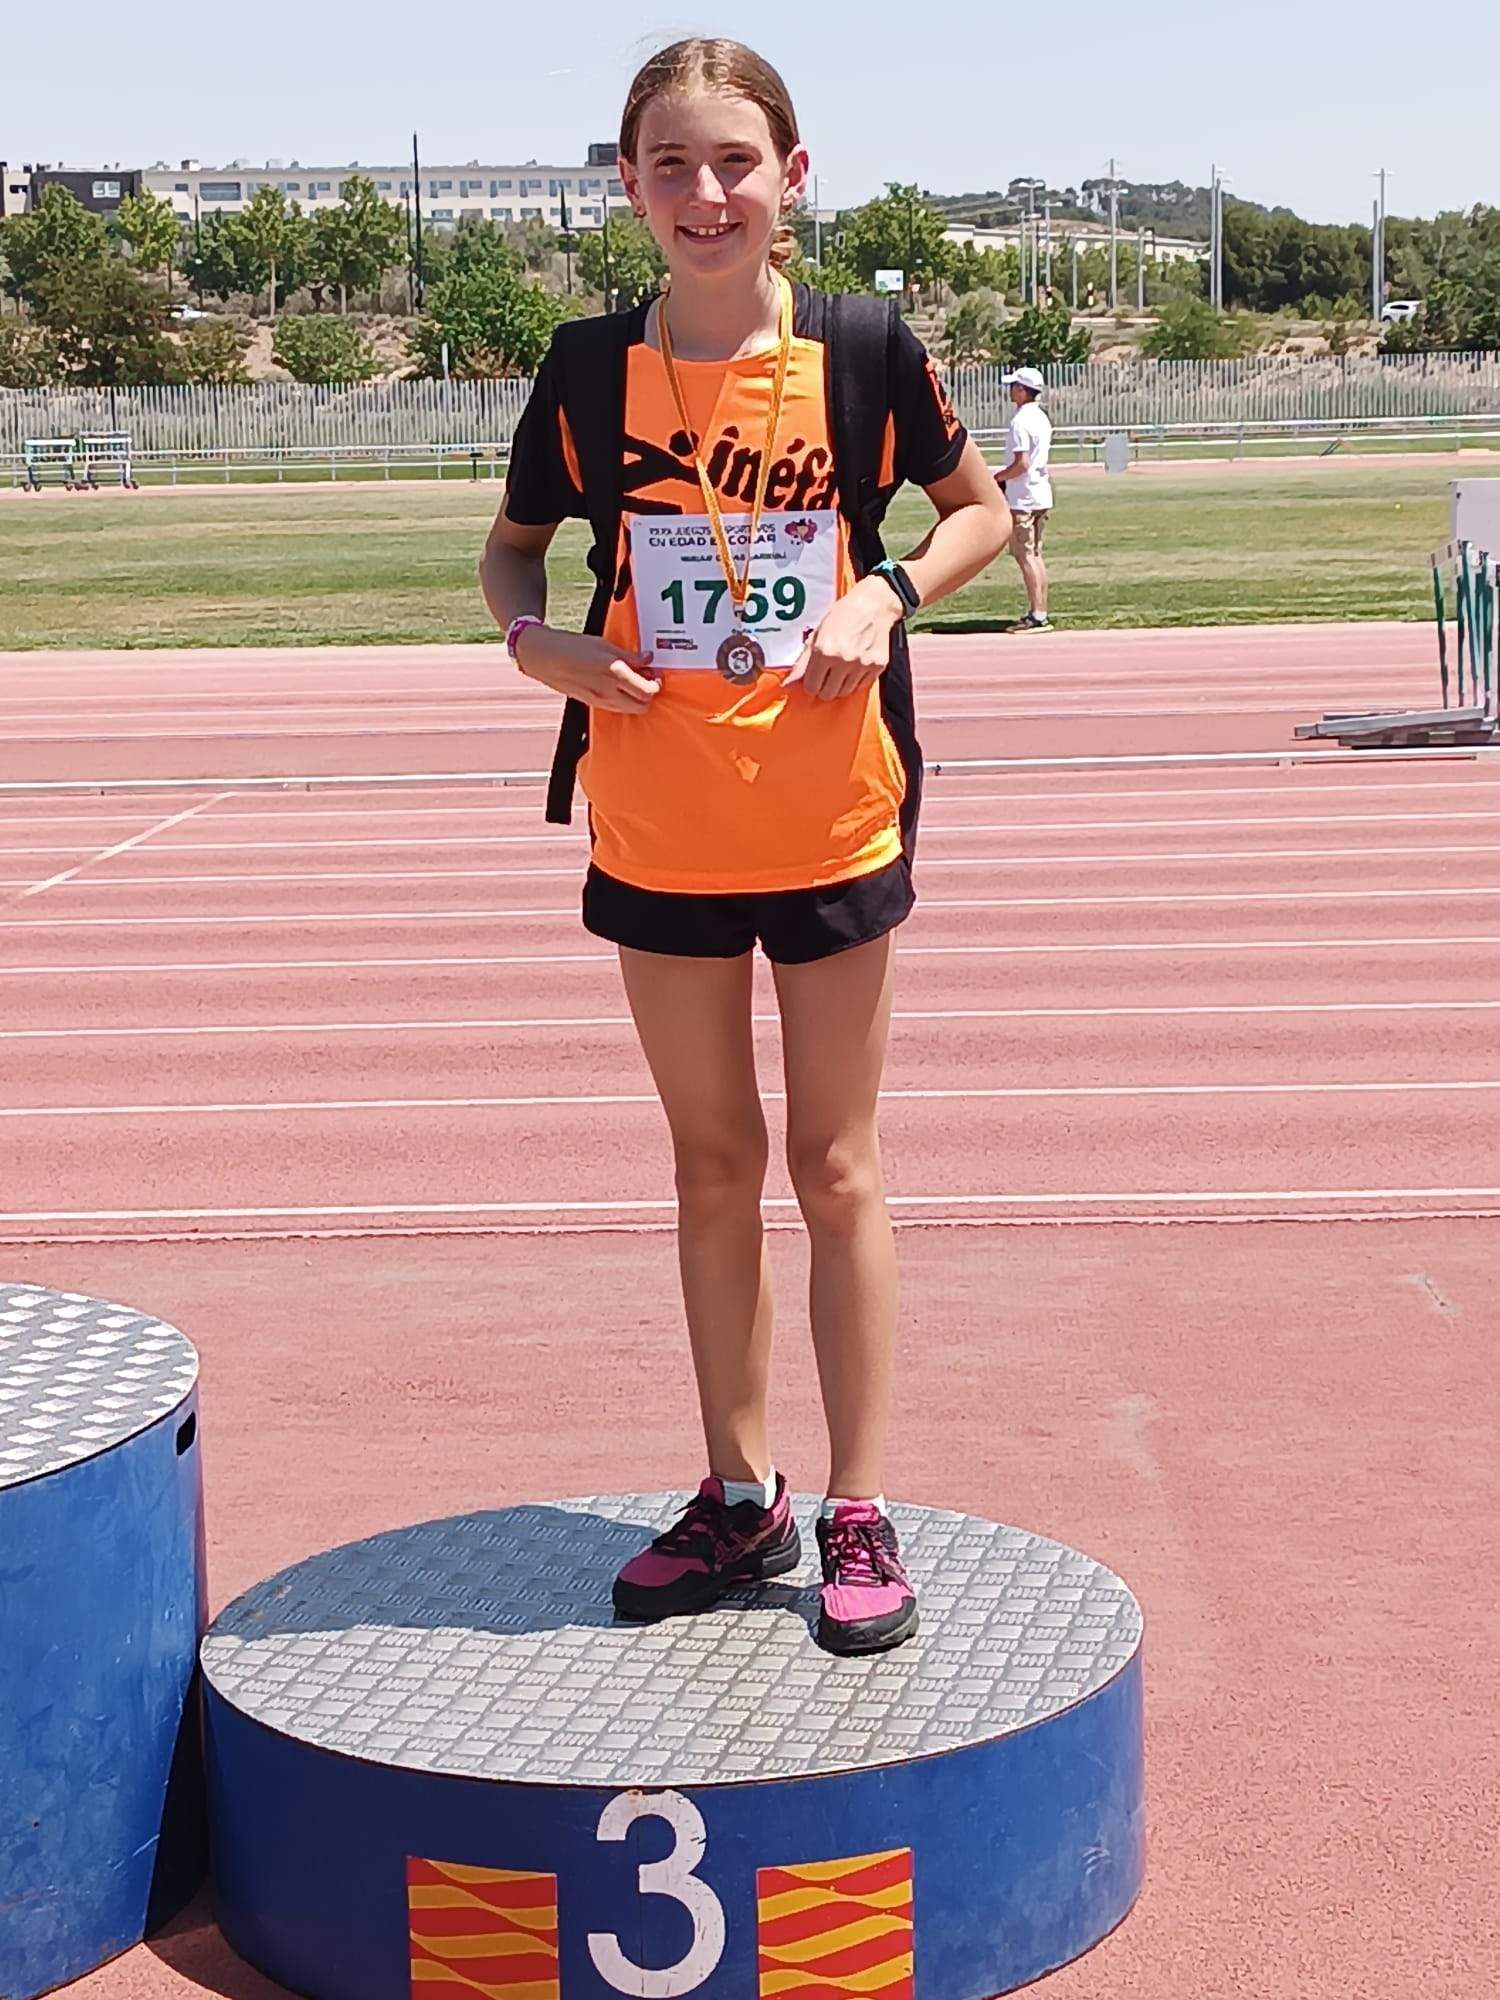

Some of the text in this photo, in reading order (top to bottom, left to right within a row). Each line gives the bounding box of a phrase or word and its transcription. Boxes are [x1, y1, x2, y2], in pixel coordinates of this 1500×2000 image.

[670, 536, 707, 547] EDAD
[661, 576, 806, 624] 1759
[587, 1788, 726, 1999] 3
